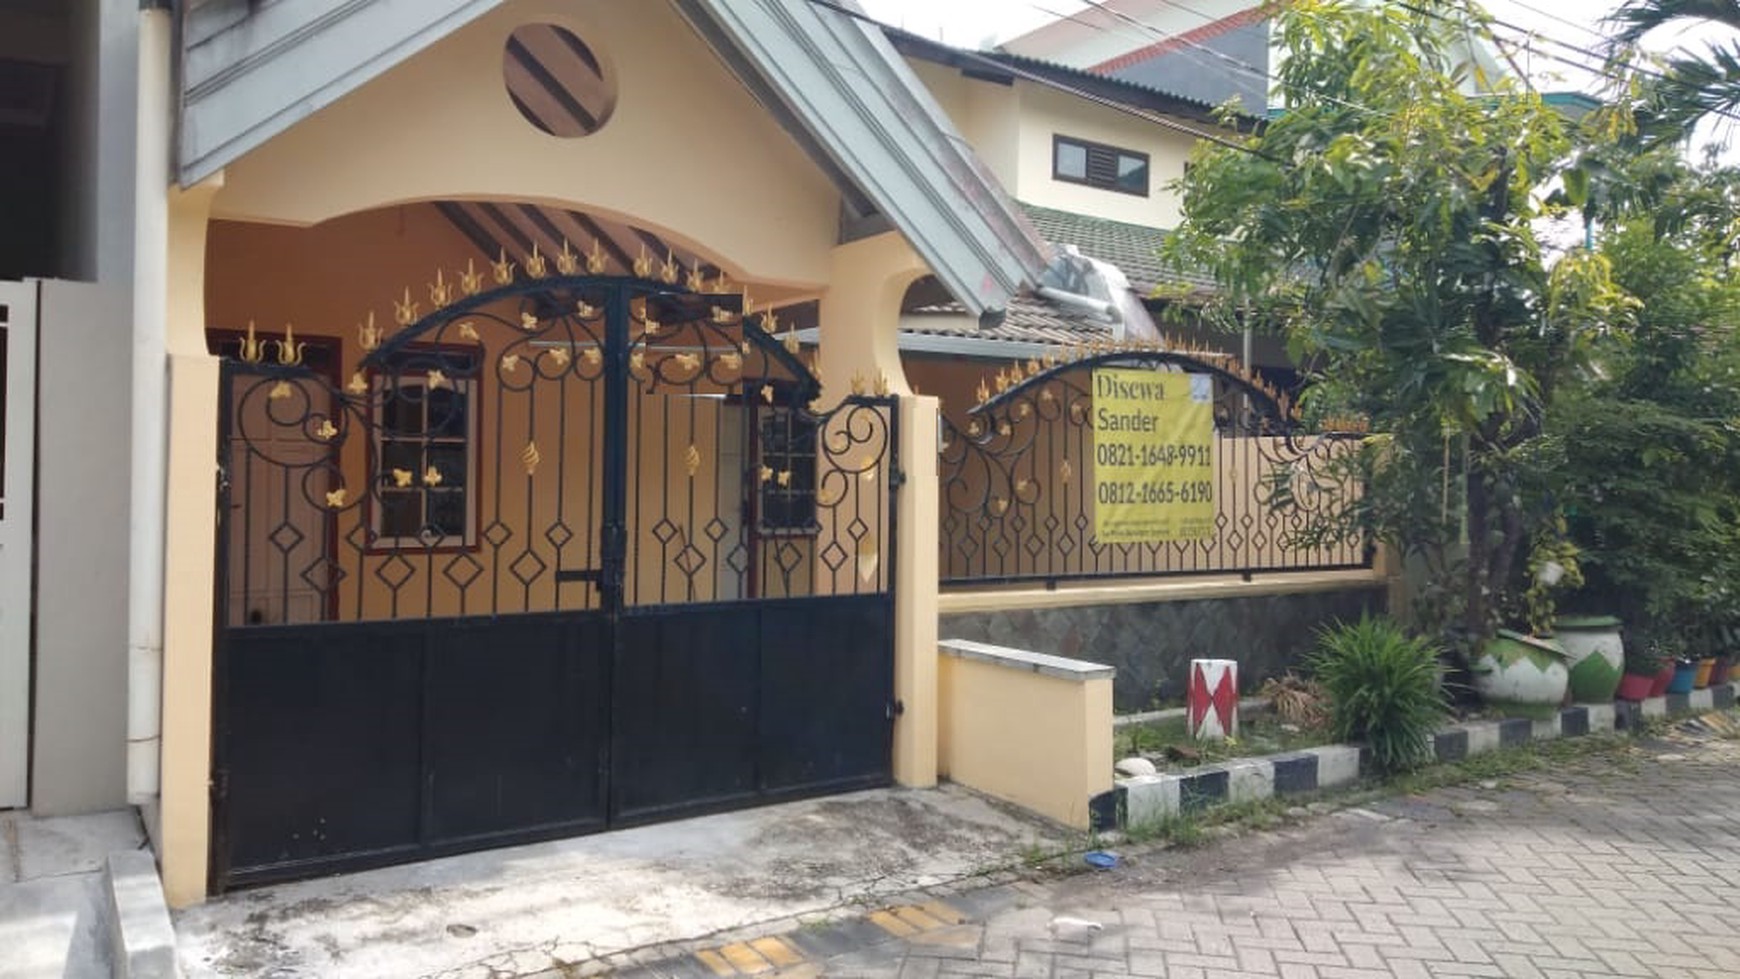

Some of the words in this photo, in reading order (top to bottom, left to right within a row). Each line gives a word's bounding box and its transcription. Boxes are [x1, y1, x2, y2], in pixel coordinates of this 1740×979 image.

[1098, 408, 1159, 432] Sander
[1097, 443, 1211, 467] 0821-1648-9911
[1098, 481, 1213, 505] 0812-1665-6190
